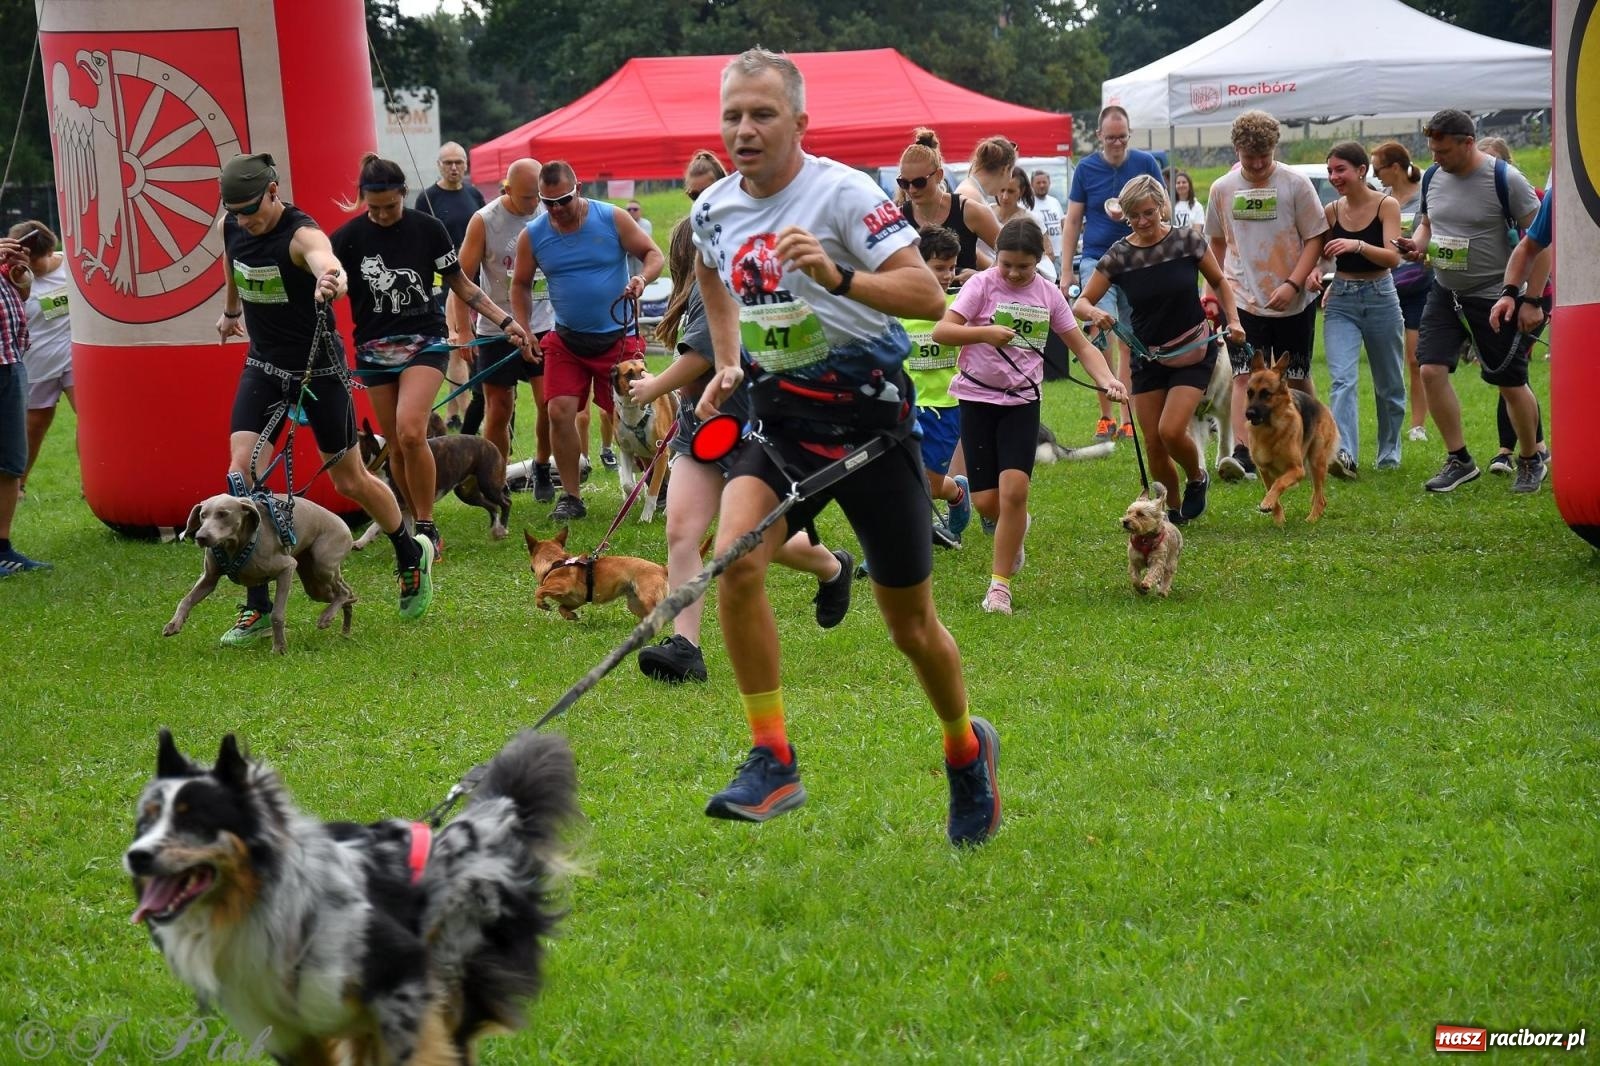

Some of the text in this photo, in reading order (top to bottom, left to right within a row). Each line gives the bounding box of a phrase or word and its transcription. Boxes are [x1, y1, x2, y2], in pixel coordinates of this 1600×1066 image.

[1228, 81, 1296, 96] Racibórz
[1246, 199, 1262, 210] 29
[1438, 247, 1453, 260] 59
[53, 295, 68, 307] 69
[1012, 319, 1033, 334] 26
[764, 327, 790, 349] 47
[920, 344, 940, 358] 50
